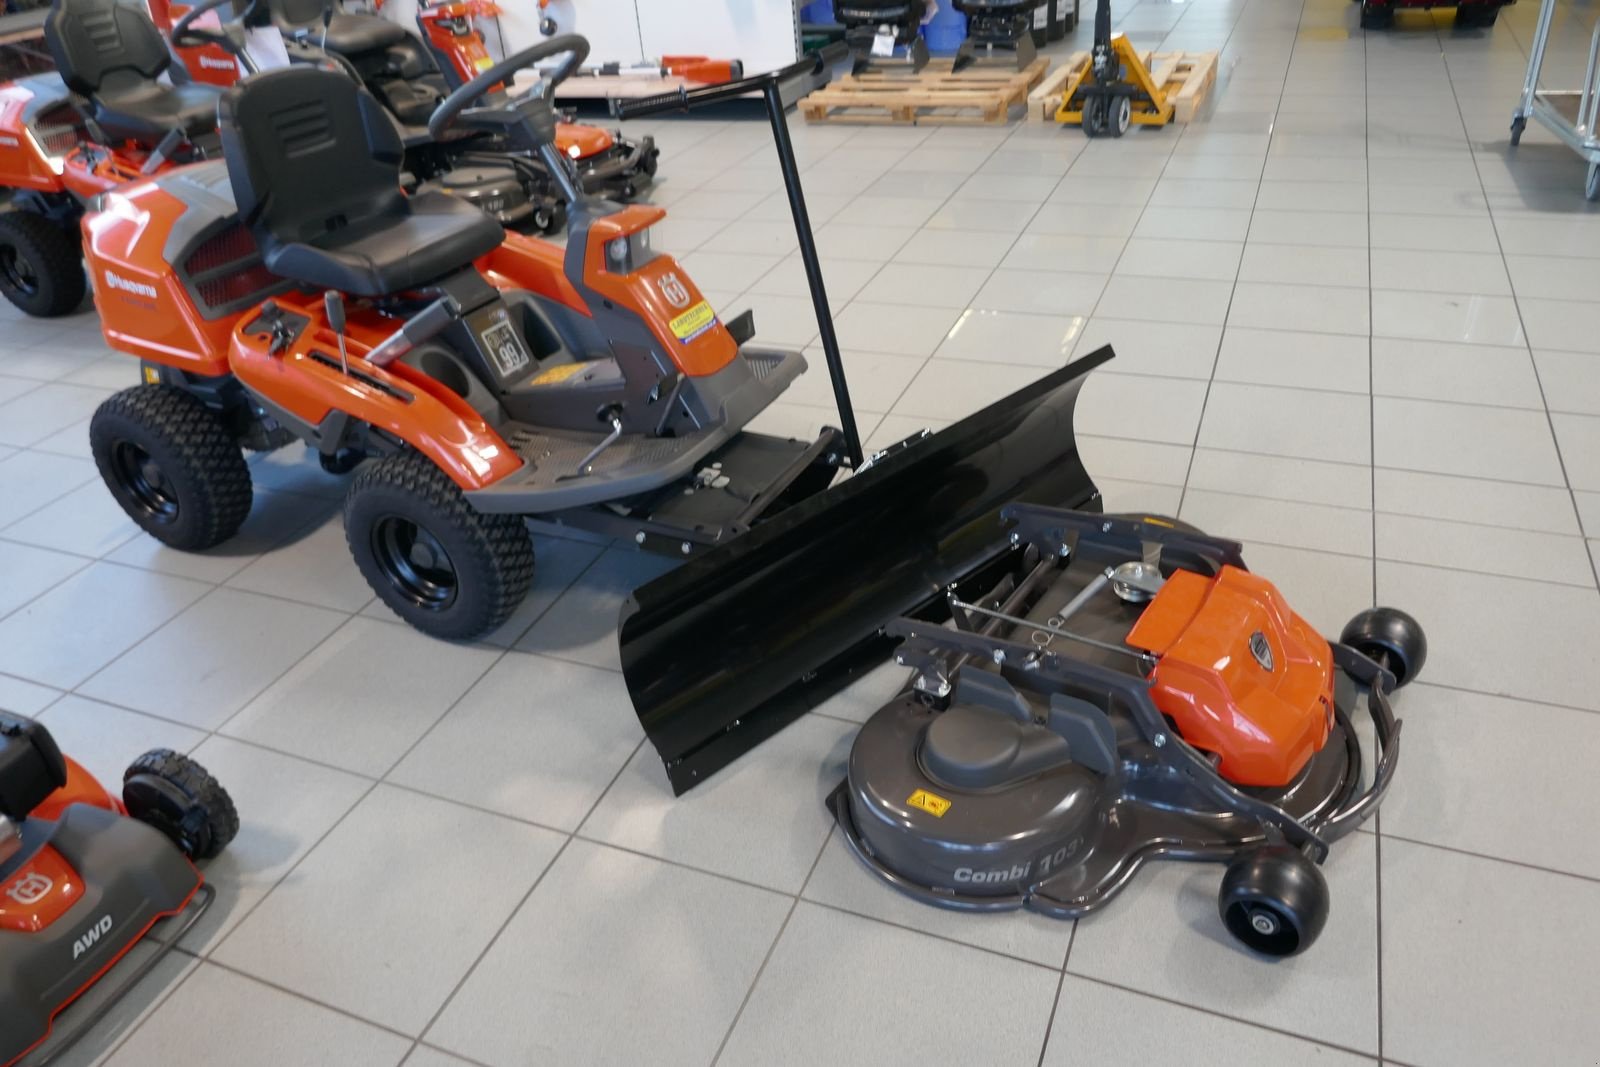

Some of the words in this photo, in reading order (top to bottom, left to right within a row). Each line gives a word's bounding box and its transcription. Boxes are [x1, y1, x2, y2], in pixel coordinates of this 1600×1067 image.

[953, 861, 1031, 883] Combi
[1040, 838, 1079, 874] 103
[73, 914, 112, 960] AWD
